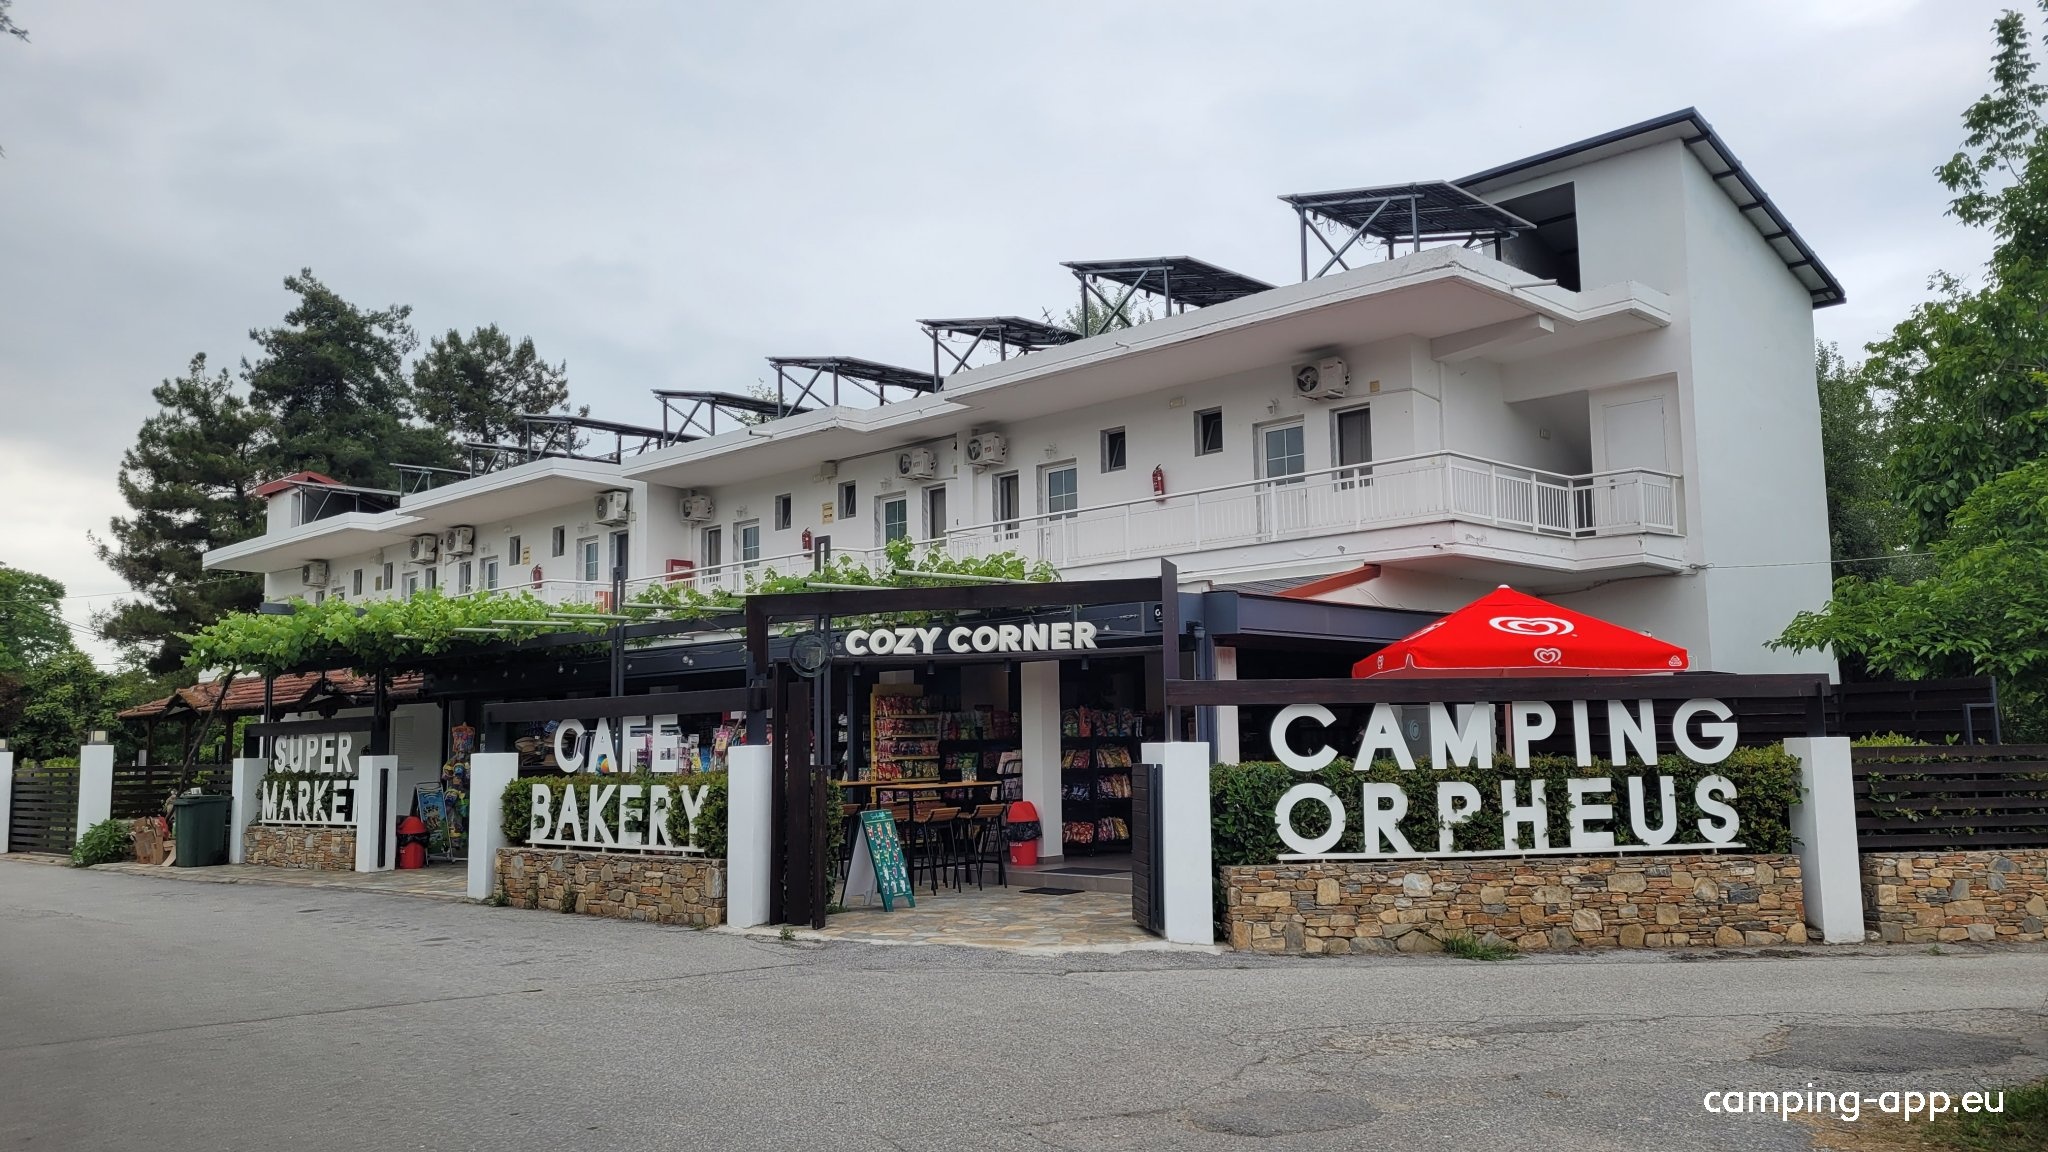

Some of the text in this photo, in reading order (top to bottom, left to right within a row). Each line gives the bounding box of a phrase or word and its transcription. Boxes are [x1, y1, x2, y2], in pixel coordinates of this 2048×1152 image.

[846, 621, 1098, 655] COZY CORNER
[274, 731, 353, 773] SUPER
[554, 714, 678, 773] CAFE
[1270, 698, 1738, 772] CAMPING
[530, 783, 709, 848] BAKERY
[1275, 775, 1740, 854] ORPHEUS
